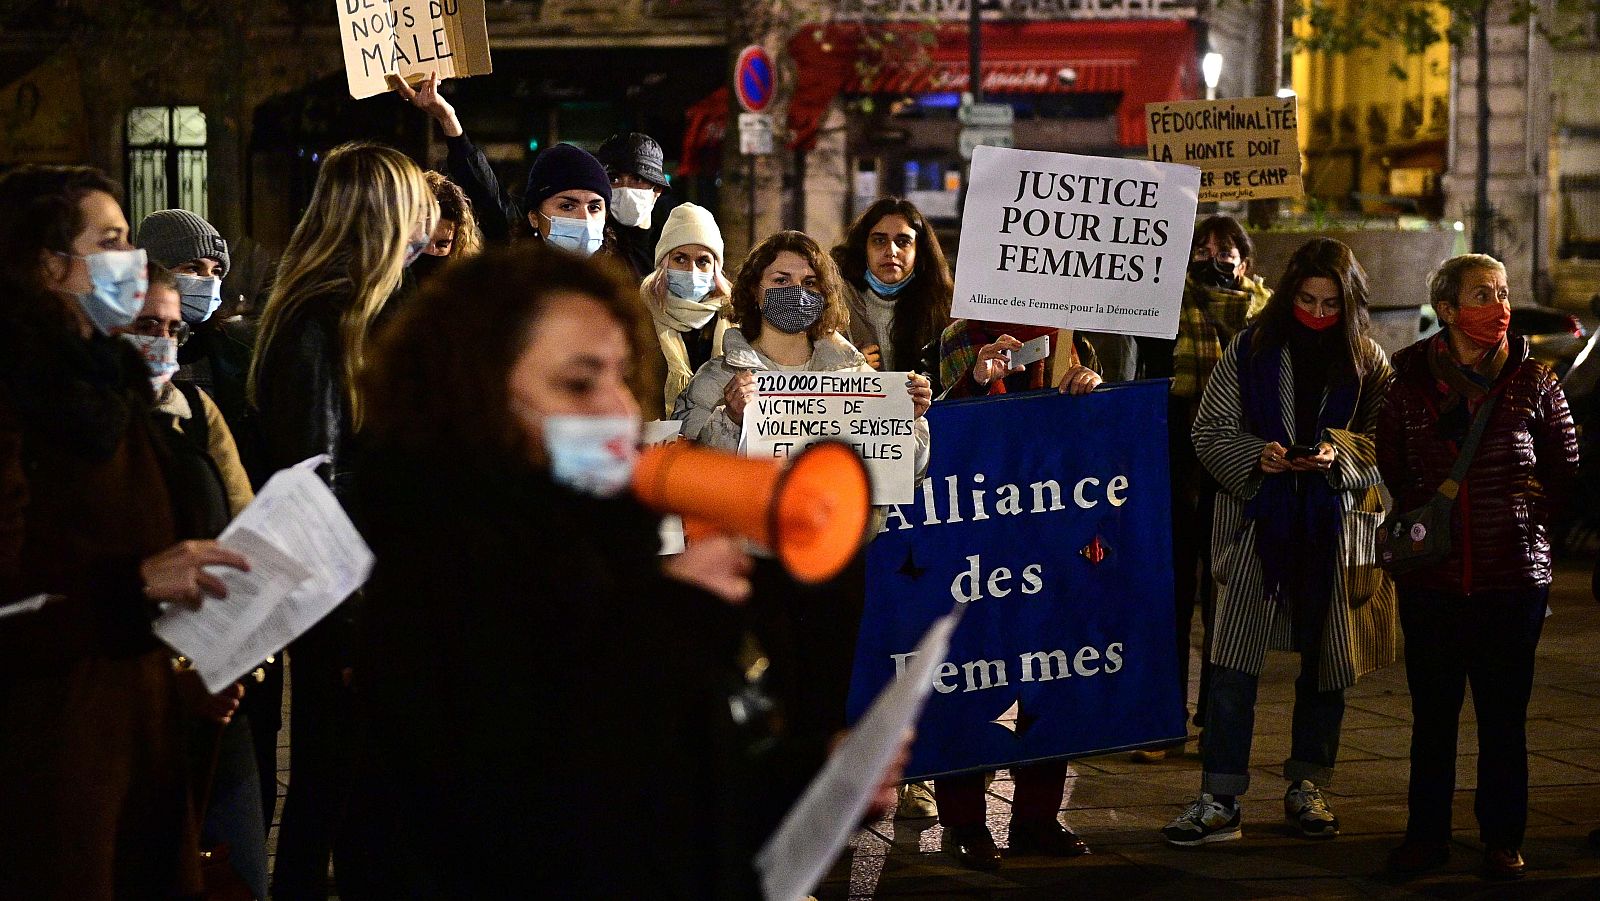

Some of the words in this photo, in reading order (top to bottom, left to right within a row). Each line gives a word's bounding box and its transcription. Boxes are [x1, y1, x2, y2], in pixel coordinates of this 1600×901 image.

[351, 6, 415, 41] NOUS
[361, 28, 454, 77] MÂLE
[1152, 143, 1173, 162] LA
[1185, 140, 1235, 160] HONTE
[1013, 170, 1159, 208] JUSTICE
[1224, 171, 1241, 186] DE
[1247, 167, 1288, 187] CAMP
[999, 206, 1101, 242] POUR
[1110, 216, 1169, 247] LES
[996, 243, 1144, 282] FEMMES
[1153, 256, 1163, 284] !
[969, 294, 1009, 306] Alliance
[1010, 297, 1026, 308] des
[1028, 298, 1069, 311] Femmes
[1070, 303, 1094, 314] pour
[1095, 304, 1104, 314] la
[1106, 304, 1160, 317] Démocratie
[820, 376, 882, 393] FEMMES
[843, 399, 864, 415] DE
[773, 442, 794, 458] ET
[950, 554, 1043, 604] des
